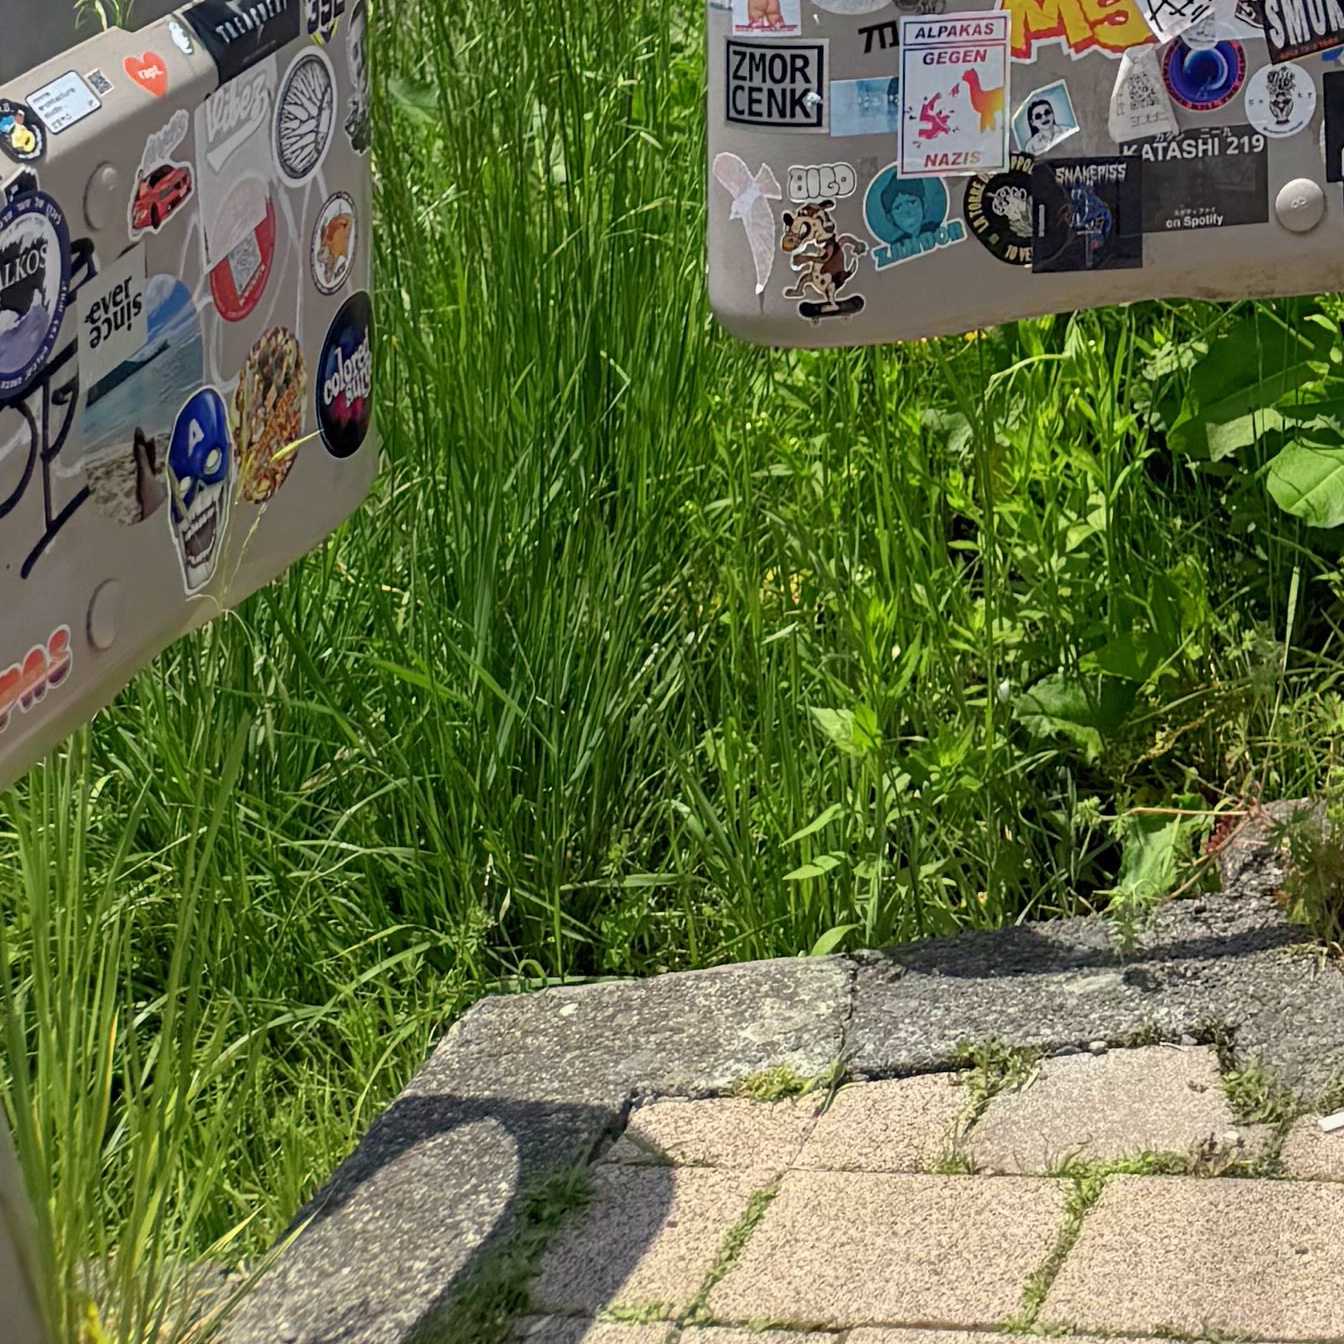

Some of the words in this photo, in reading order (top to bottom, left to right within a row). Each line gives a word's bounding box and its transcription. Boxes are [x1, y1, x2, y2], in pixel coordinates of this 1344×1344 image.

[914, 21, 995, 40] ALPAKAS
[731, 49, 812, 85] ZMOR
[921, 48, 988, 66] GEGEN
[731, 84, 812, 120] CENK
[923, 150, 982, 168] NAZIS
[1122, 138, 1219, 162] KATASHI
[1226, 135, 1264, 155] 219
[1166, 219, 1181, 228] on
[1183, 213, 1224, 229] Spotify
[89, 274, 133, 325] ever
